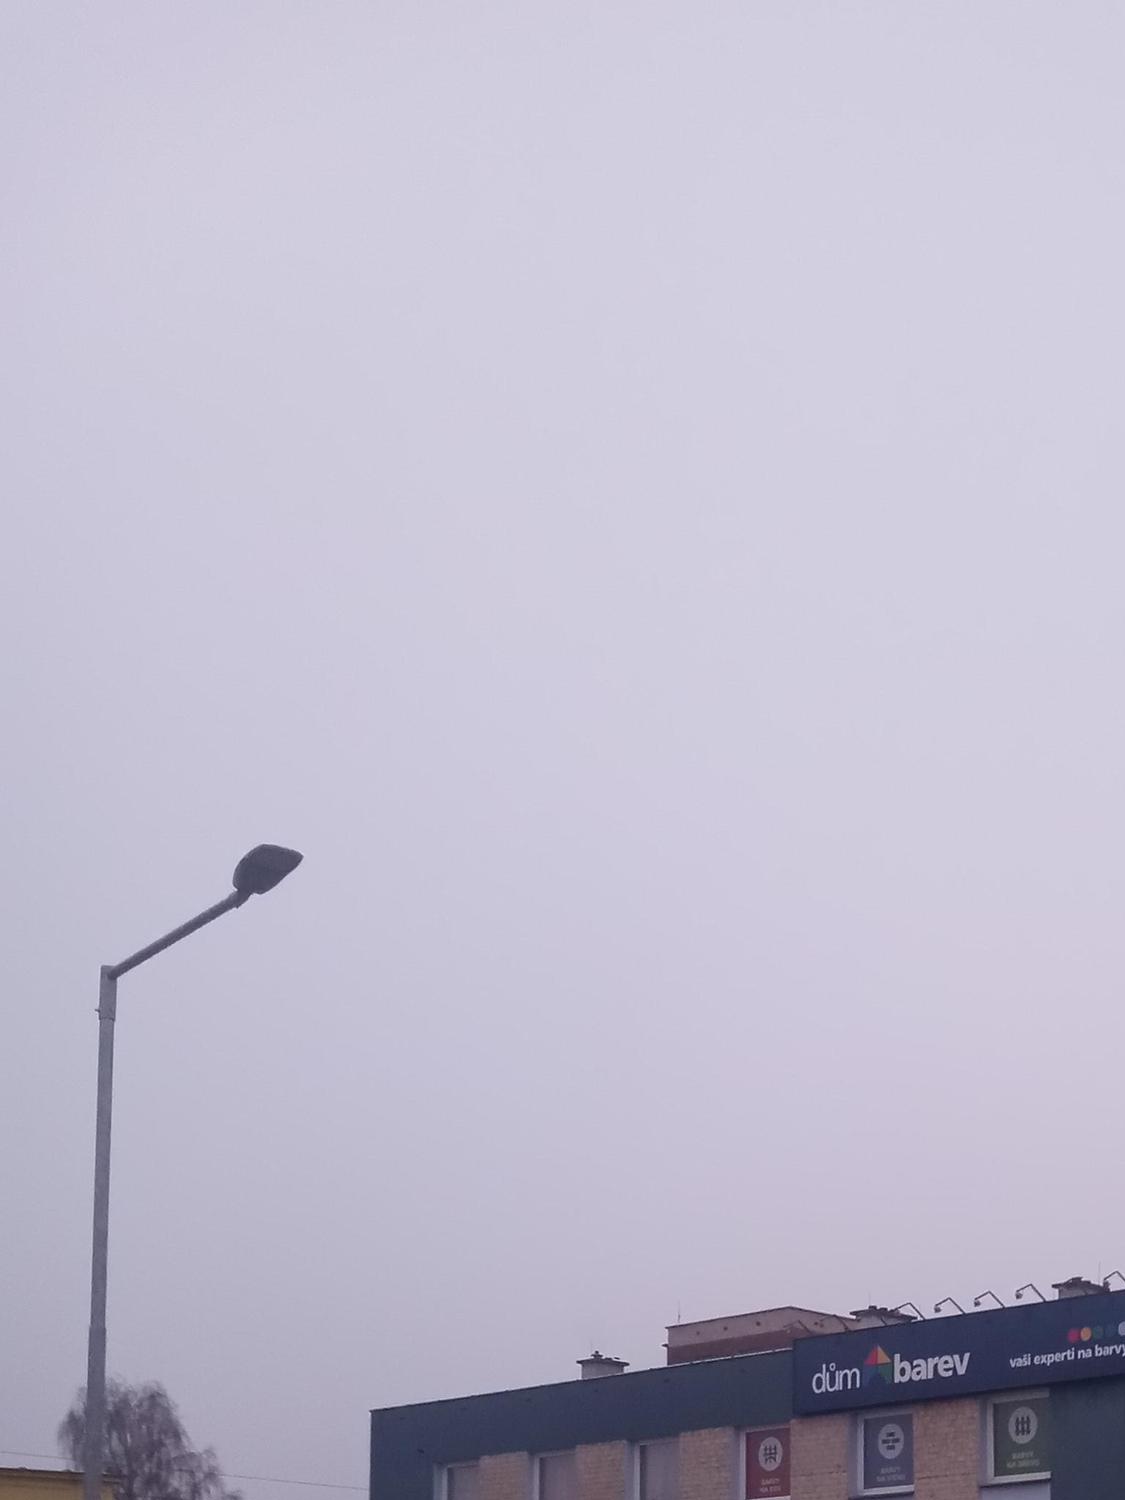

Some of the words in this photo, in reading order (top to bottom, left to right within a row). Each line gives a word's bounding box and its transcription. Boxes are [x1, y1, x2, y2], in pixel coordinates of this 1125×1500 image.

[812, 1363, 860, 1394] dům
[893, 1352, 971, 1384] barev
[1010, 1353, 1031, 1368] vaši
[1033, 1347, 1075, 1366] experti
[1077, 1348, 1092, 1359] na
